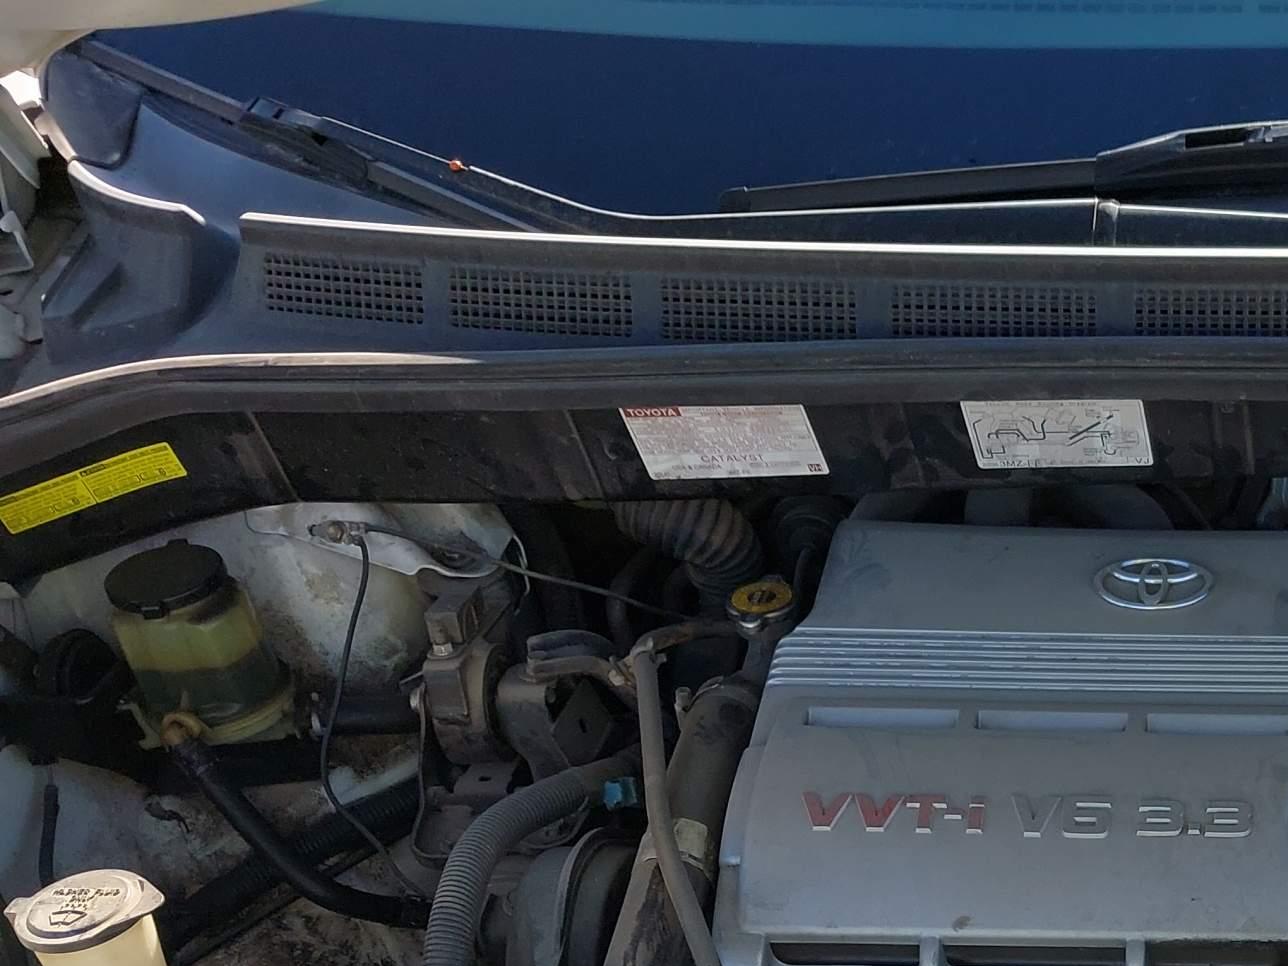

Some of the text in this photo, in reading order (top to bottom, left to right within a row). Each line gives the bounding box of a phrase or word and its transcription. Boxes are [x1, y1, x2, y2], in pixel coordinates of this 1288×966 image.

[627, 408, 677, 417] TOYOTA
[701, 454, 764, 463] CATALYST
[1011, 793, 1113, 839] V6
[1136, 798, 1256, 839] 3.3
